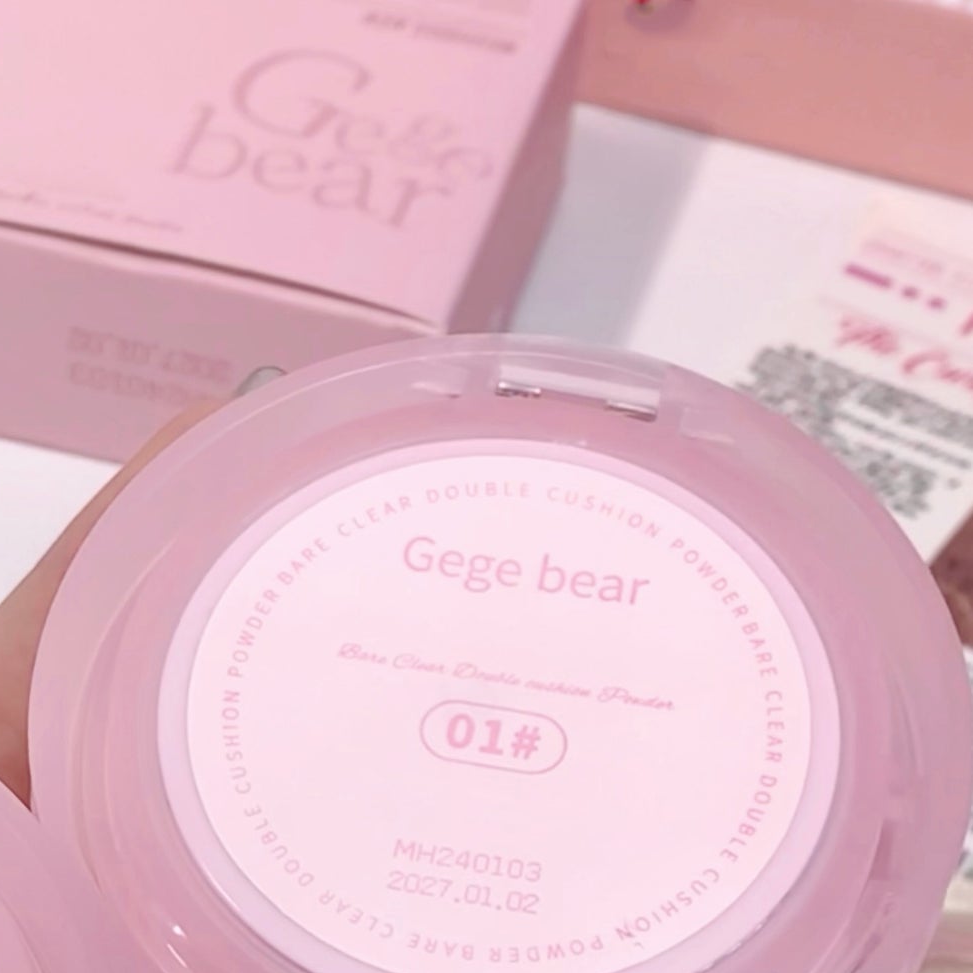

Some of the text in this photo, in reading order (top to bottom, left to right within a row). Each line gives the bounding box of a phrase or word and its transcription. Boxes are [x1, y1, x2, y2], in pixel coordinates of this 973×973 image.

[169, 104, 452, 229] bear
[232, 47, 493, 182] Gege
[274, 480, 751, 620] BARE CLEAR DOUBLE CUSHION POWDER
[402, 535, 651, 606] Gege bear
[220, 588, 476, 962] BARE CLEAR DOUBLE CUSHION POWDER
[444, 712, 542, 760] 01#
[488, 618, 785, 964] BARE CLEAR DOUBLE CUSHION POWDER
[385, 868, 541, 916] 2027.01.02
[391, 836, 543, 883] MH240103
